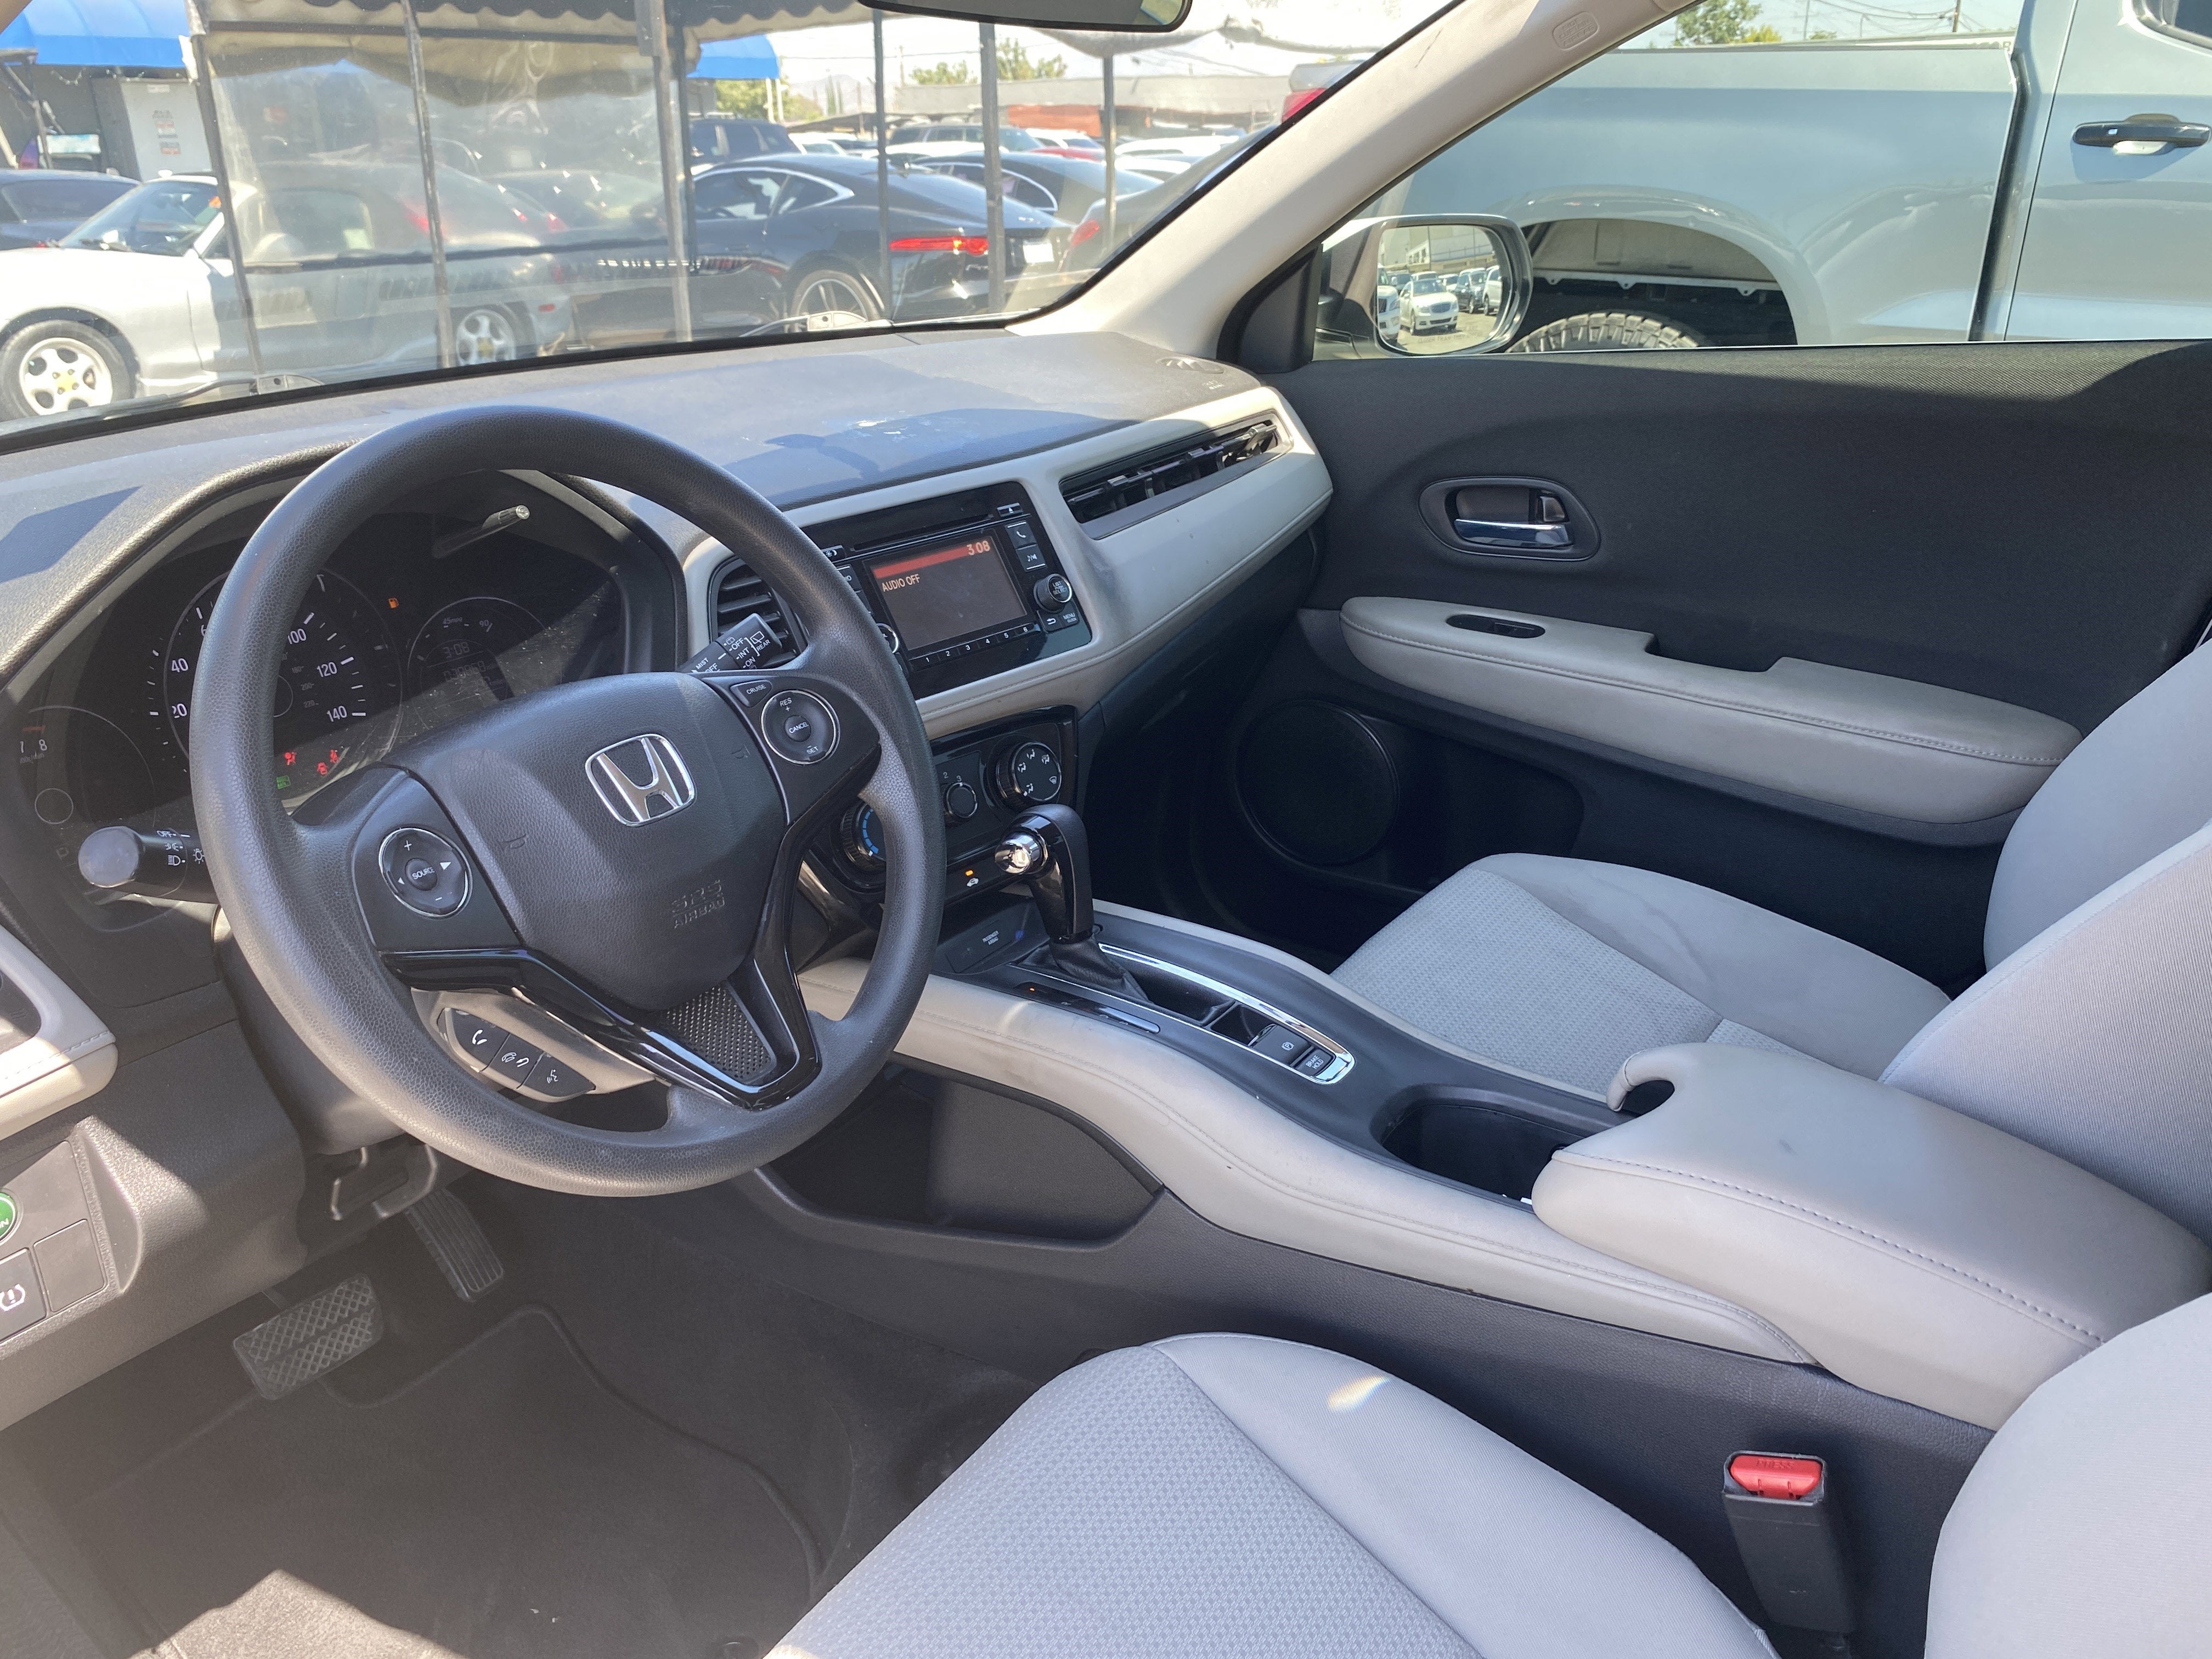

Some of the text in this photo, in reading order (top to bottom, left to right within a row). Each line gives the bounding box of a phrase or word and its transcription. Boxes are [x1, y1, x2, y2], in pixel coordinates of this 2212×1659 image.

[882, 574, 921, 592] AUDIO OFF
[287, 628, 307, 645] 100
[731, 637, 744, 651] OFF
[756, 639, 771, 652] REAR
[738, 647, 750, 659] INT
[171, 658, 189, 673] 40
[695, 657, 709, 670] MIST
[745, 656, 757, 667] ON
[317, 662, 338, 678] 120
[746, 684, 766, 695] CRUISE
[780, 697, 792, 707] RES
[326, 706, 348, 723] 140
[789, 721, 809, 733] CANCEL
[39, 739, 47, 751] 8
[806, 746, 819, 755] SET
[411, 866, 435, 880] SOURCE
[674, 893, 725, 929] AIRBAG
[1305, 1054, 1320, 1068] BRAKE
[1311, 1059, 1324, 1070] HOLD
[1756, 1460, 1795, 1470] PRESS
